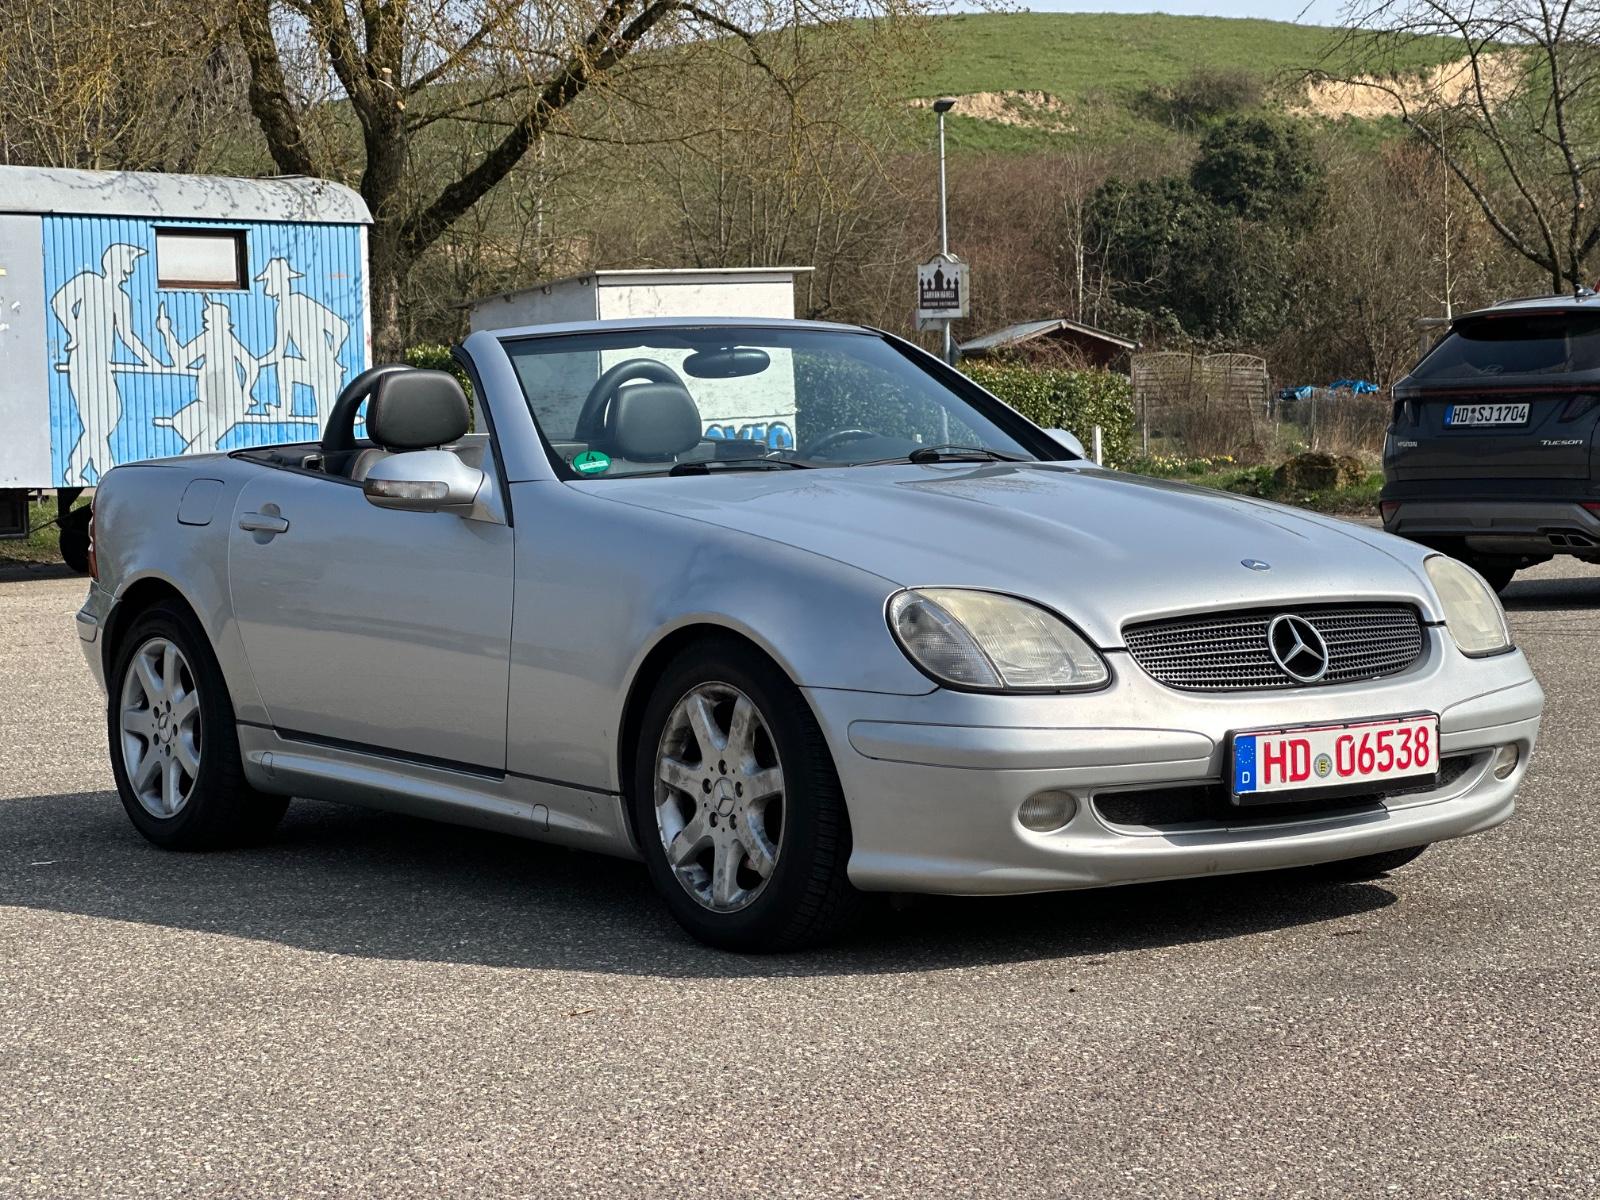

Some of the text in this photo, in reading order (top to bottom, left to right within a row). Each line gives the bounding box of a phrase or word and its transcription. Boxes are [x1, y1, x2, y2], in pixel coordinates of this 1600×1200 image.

[1452, 407, 1469, 423] HD
[1263, 726, 1430, 785] HD 06538
[1241, 771, 1251, 784] D
